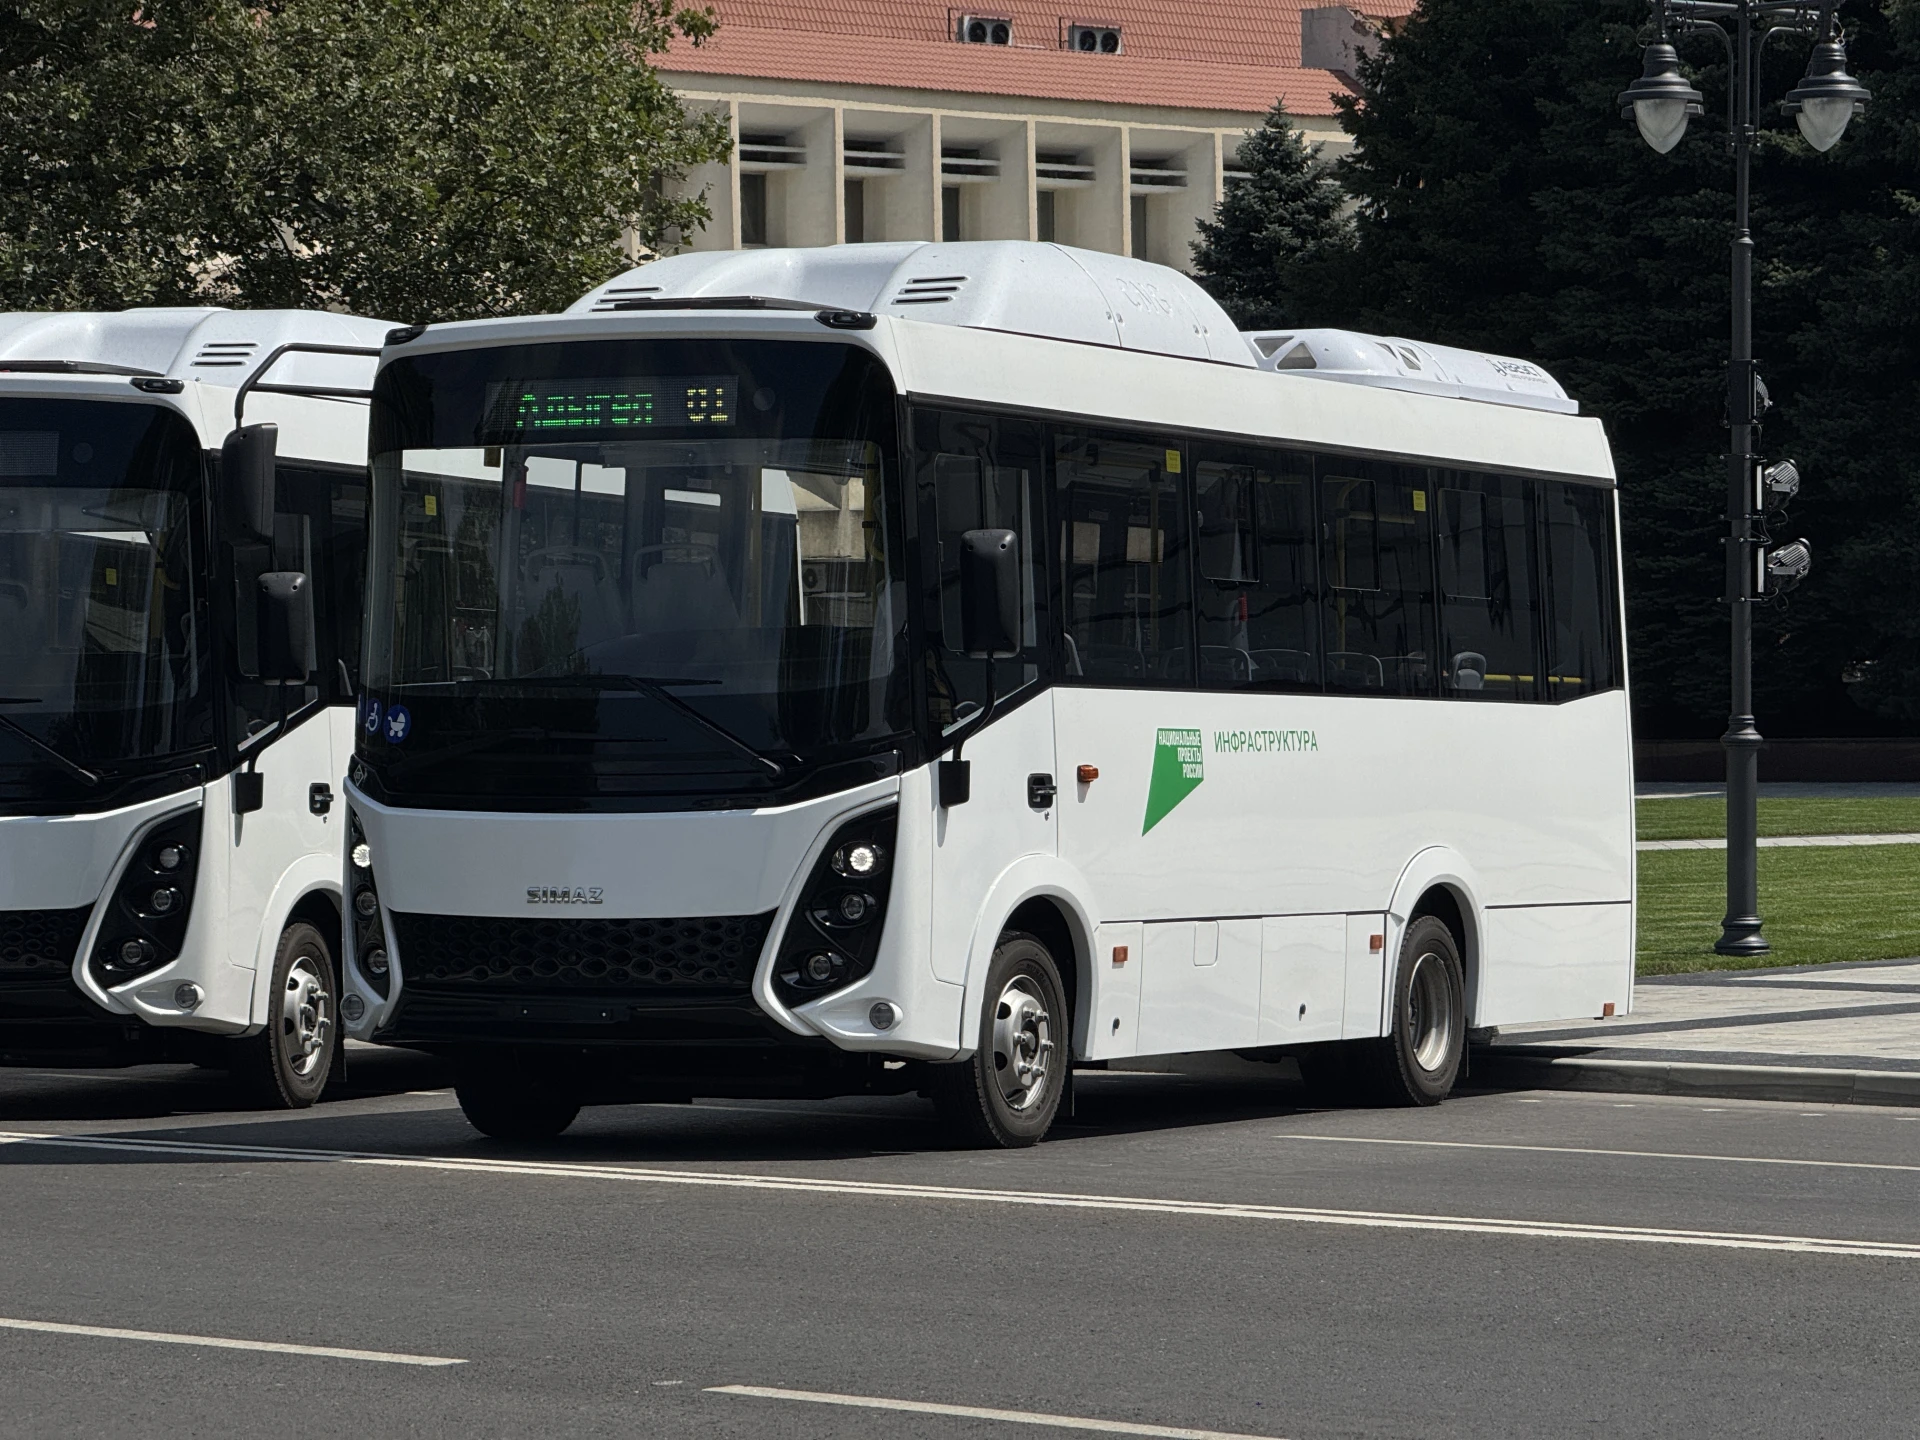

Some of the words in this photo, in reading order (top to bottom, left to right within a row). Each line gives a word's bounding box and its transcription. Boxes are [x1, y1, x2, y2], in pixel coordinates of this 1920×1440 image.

[686, 388, 728, 422] 01
[1158, 730, 1201, 747] НАЦИОНАЛЬНЫЕ
[1213, 730, 1318, 752] ИНФРАСТРУКТУРА
[1177, 747, 1202, 762] ПРОЕКТЫ
[1182, 763, 1203, 778] РОССИИ
[527, 886, 604, 904] SIMAZ
